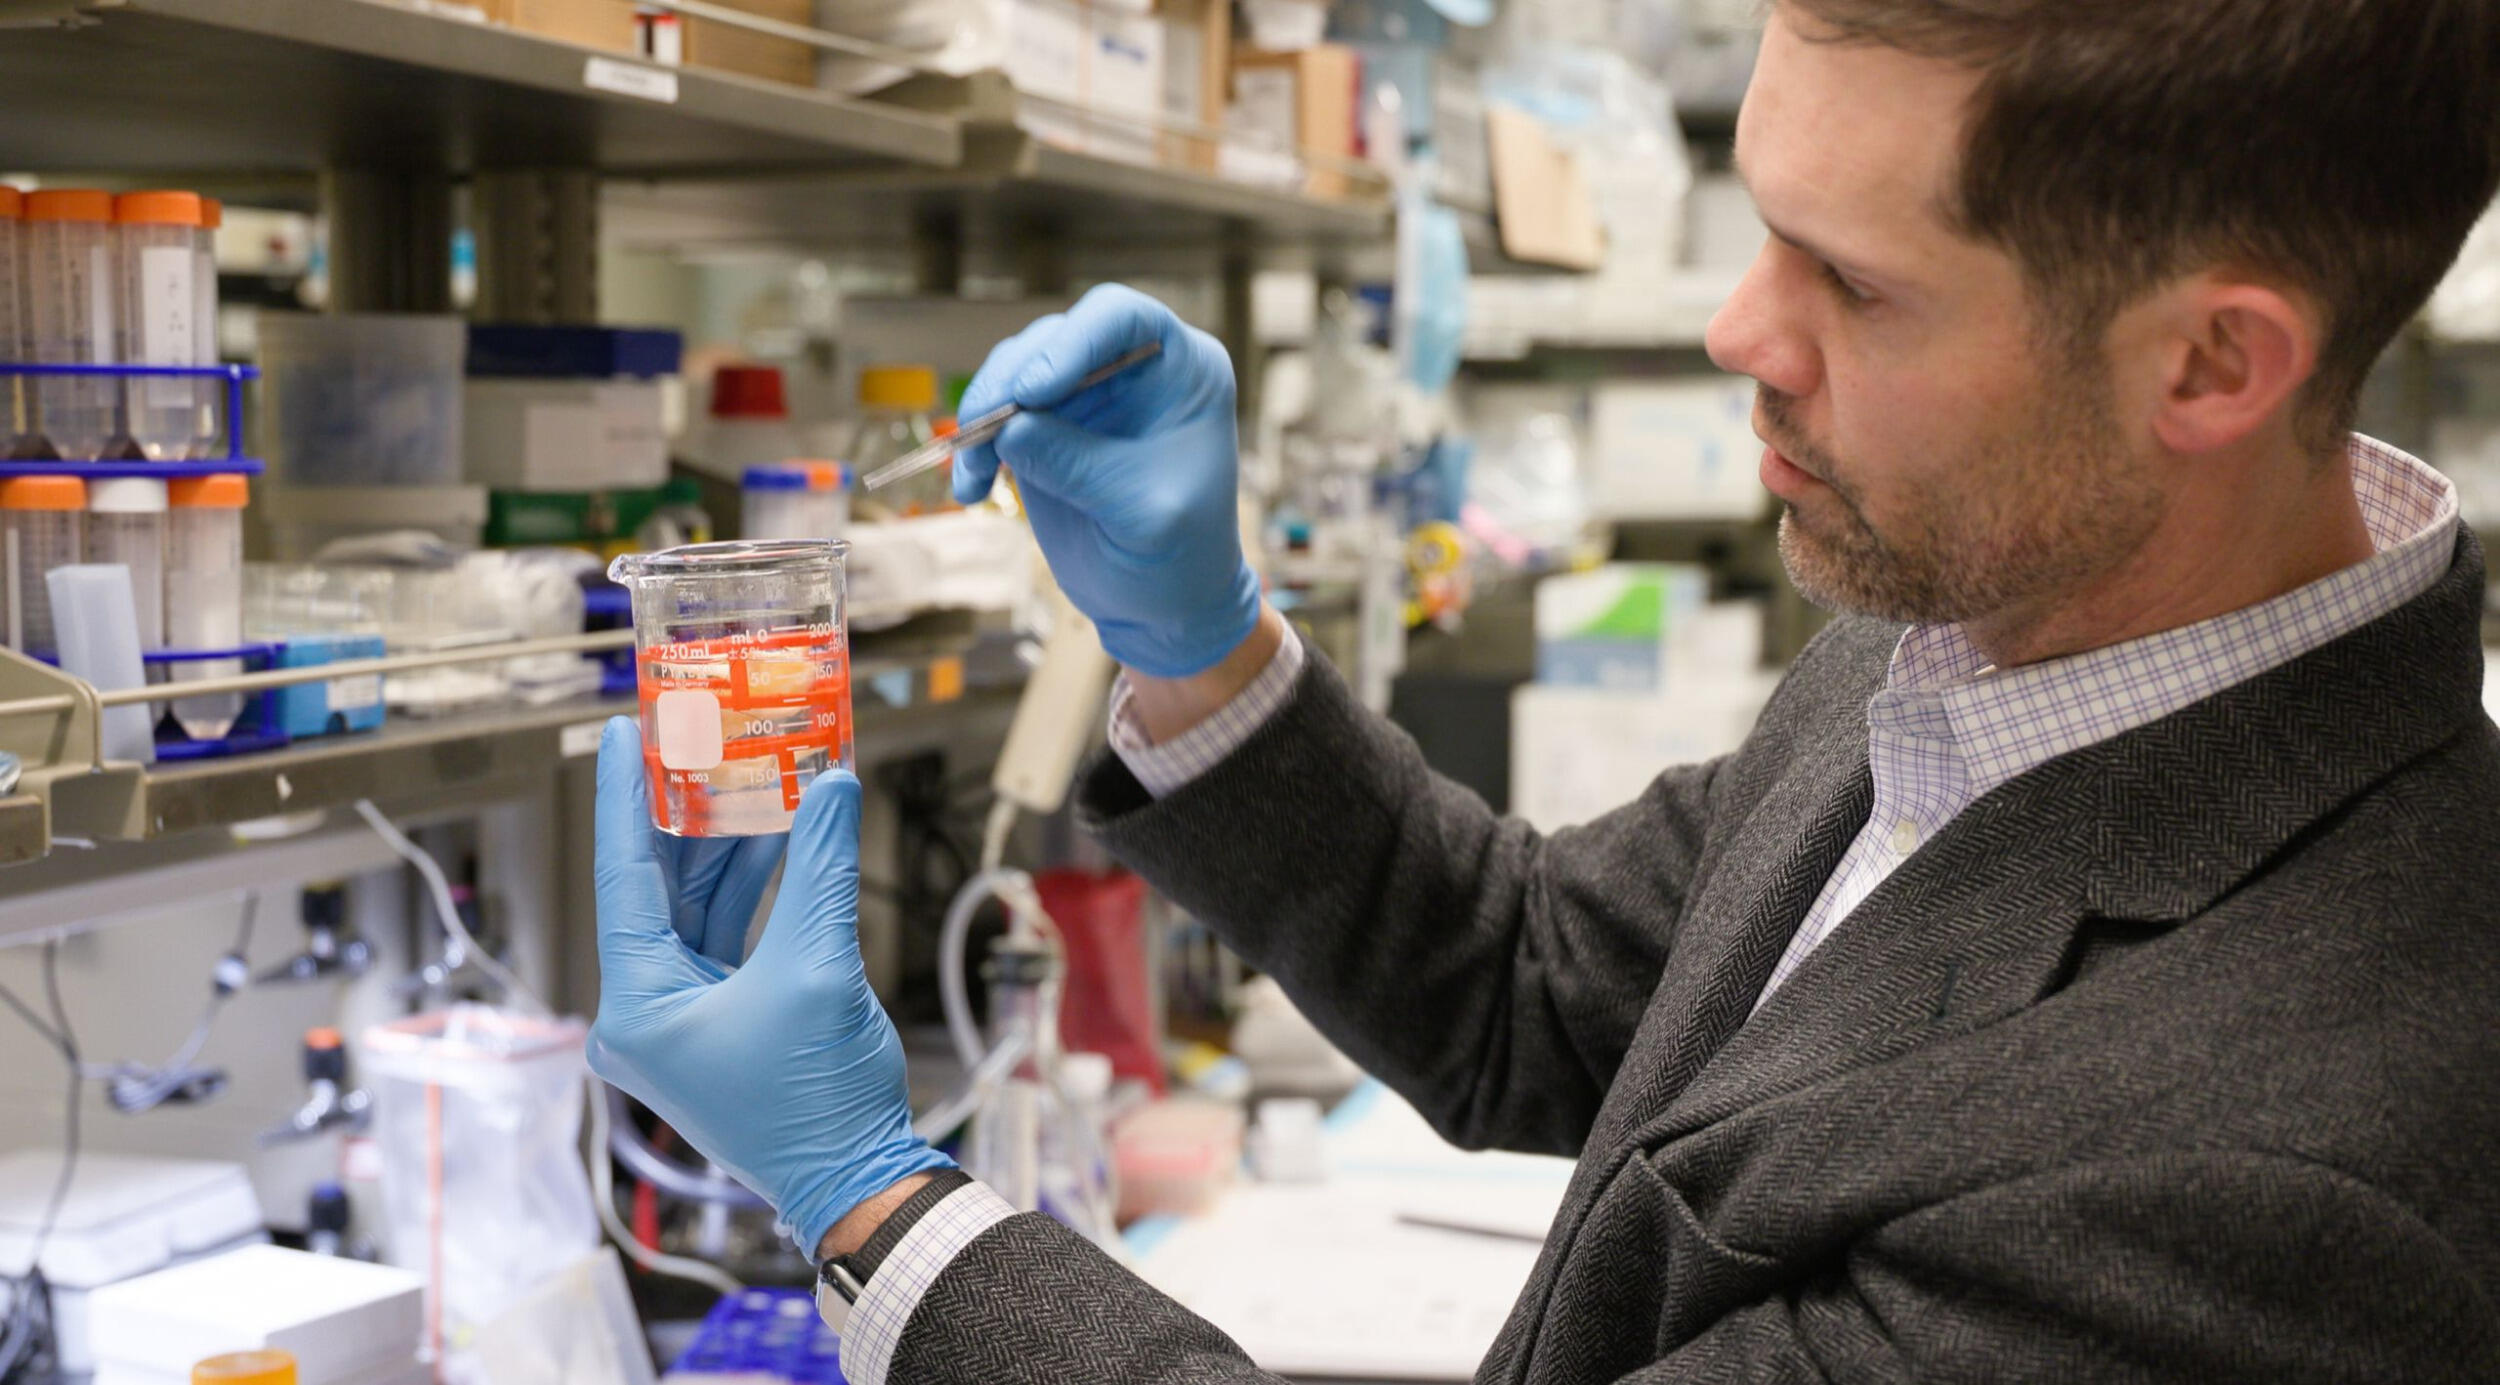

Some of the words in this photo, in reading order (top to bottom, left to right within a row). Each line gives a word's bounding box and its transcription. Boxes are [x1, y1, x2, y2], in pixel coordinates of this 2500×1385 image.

[809, 622, 831, 638] 200
[750, 671, 771, 687] 50
[815, 664, 833, 679] 150
[816, 711, 836, 728] 100
[744, 719, 773, 736] 100
[826, 760, 840, 770] 50
[670, 773, 685, 784] No.
[687, 773, 710, 784] 1003
[750, 768, 776, 783] 150
